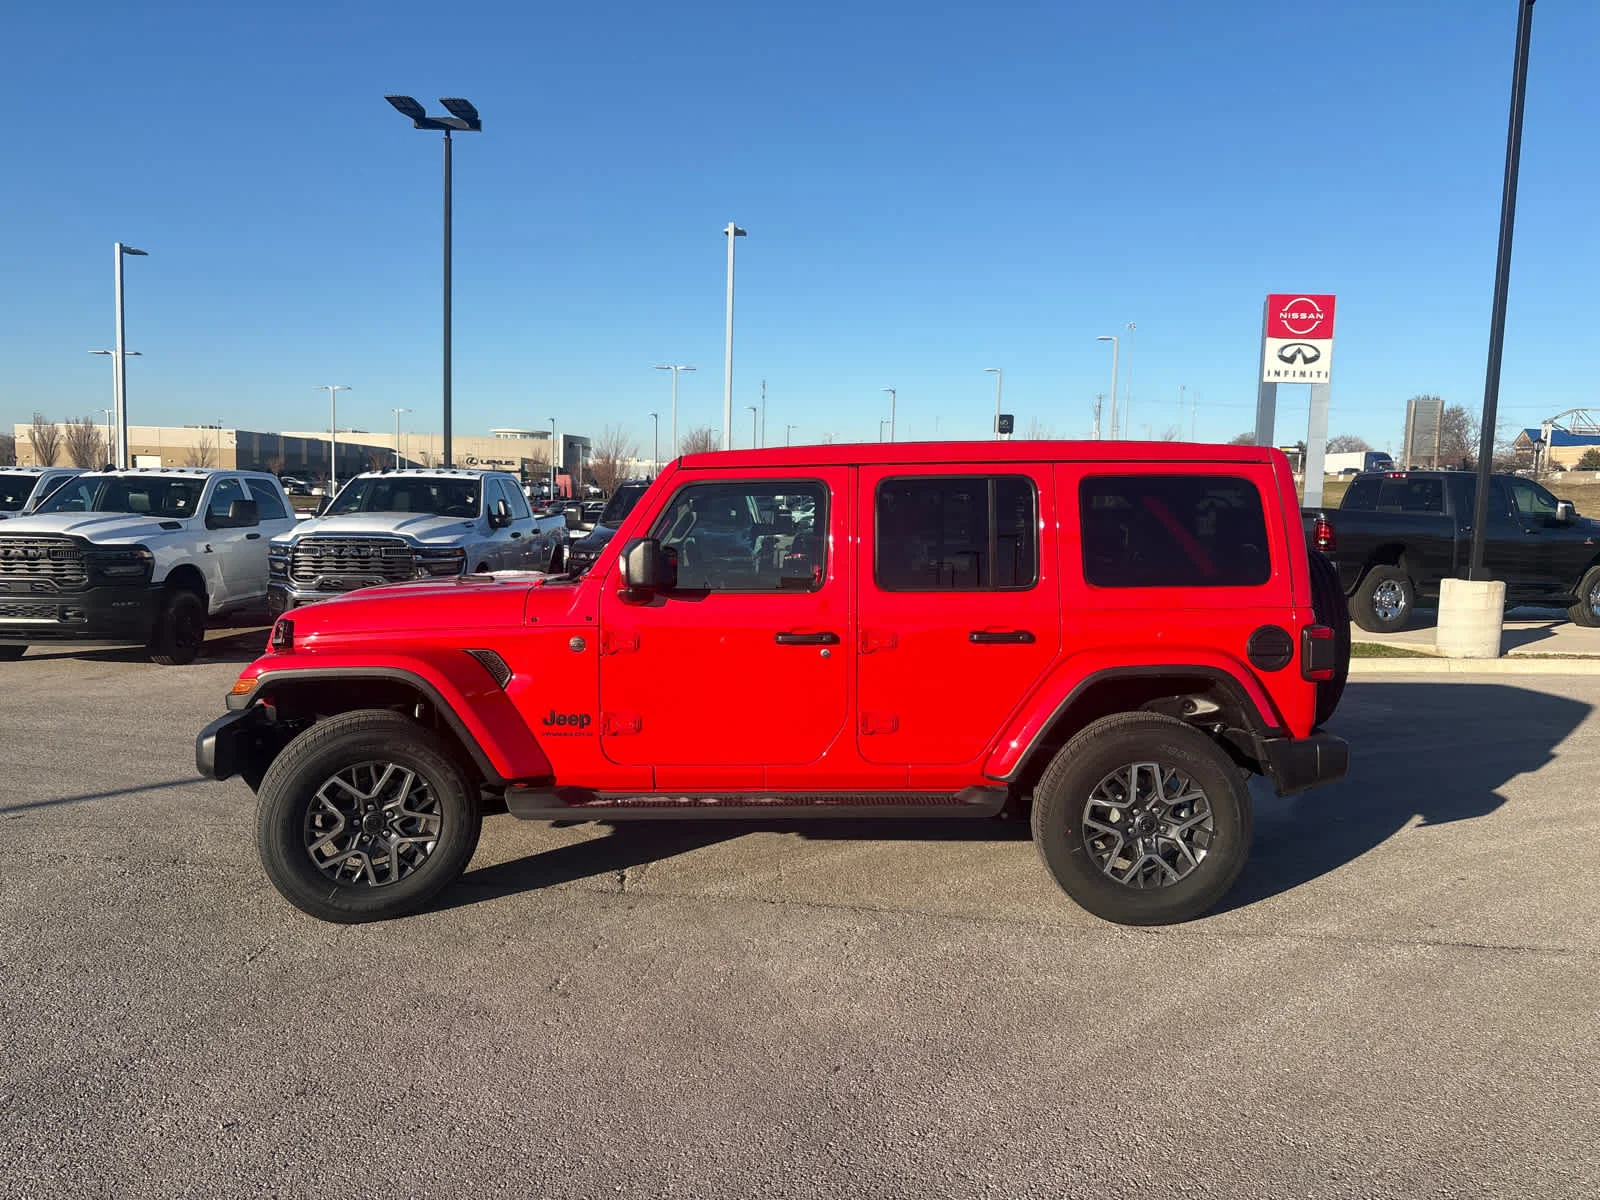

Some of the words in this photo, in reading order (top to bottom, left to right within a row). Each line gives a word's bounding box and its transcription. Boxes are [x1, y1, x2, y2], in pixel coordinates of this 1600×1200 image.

[1279, 312, 1324, 320] NISSAN
[1266, 369, 1329, 379] INFINITI
[542, 709, 592, 729] Jeep
